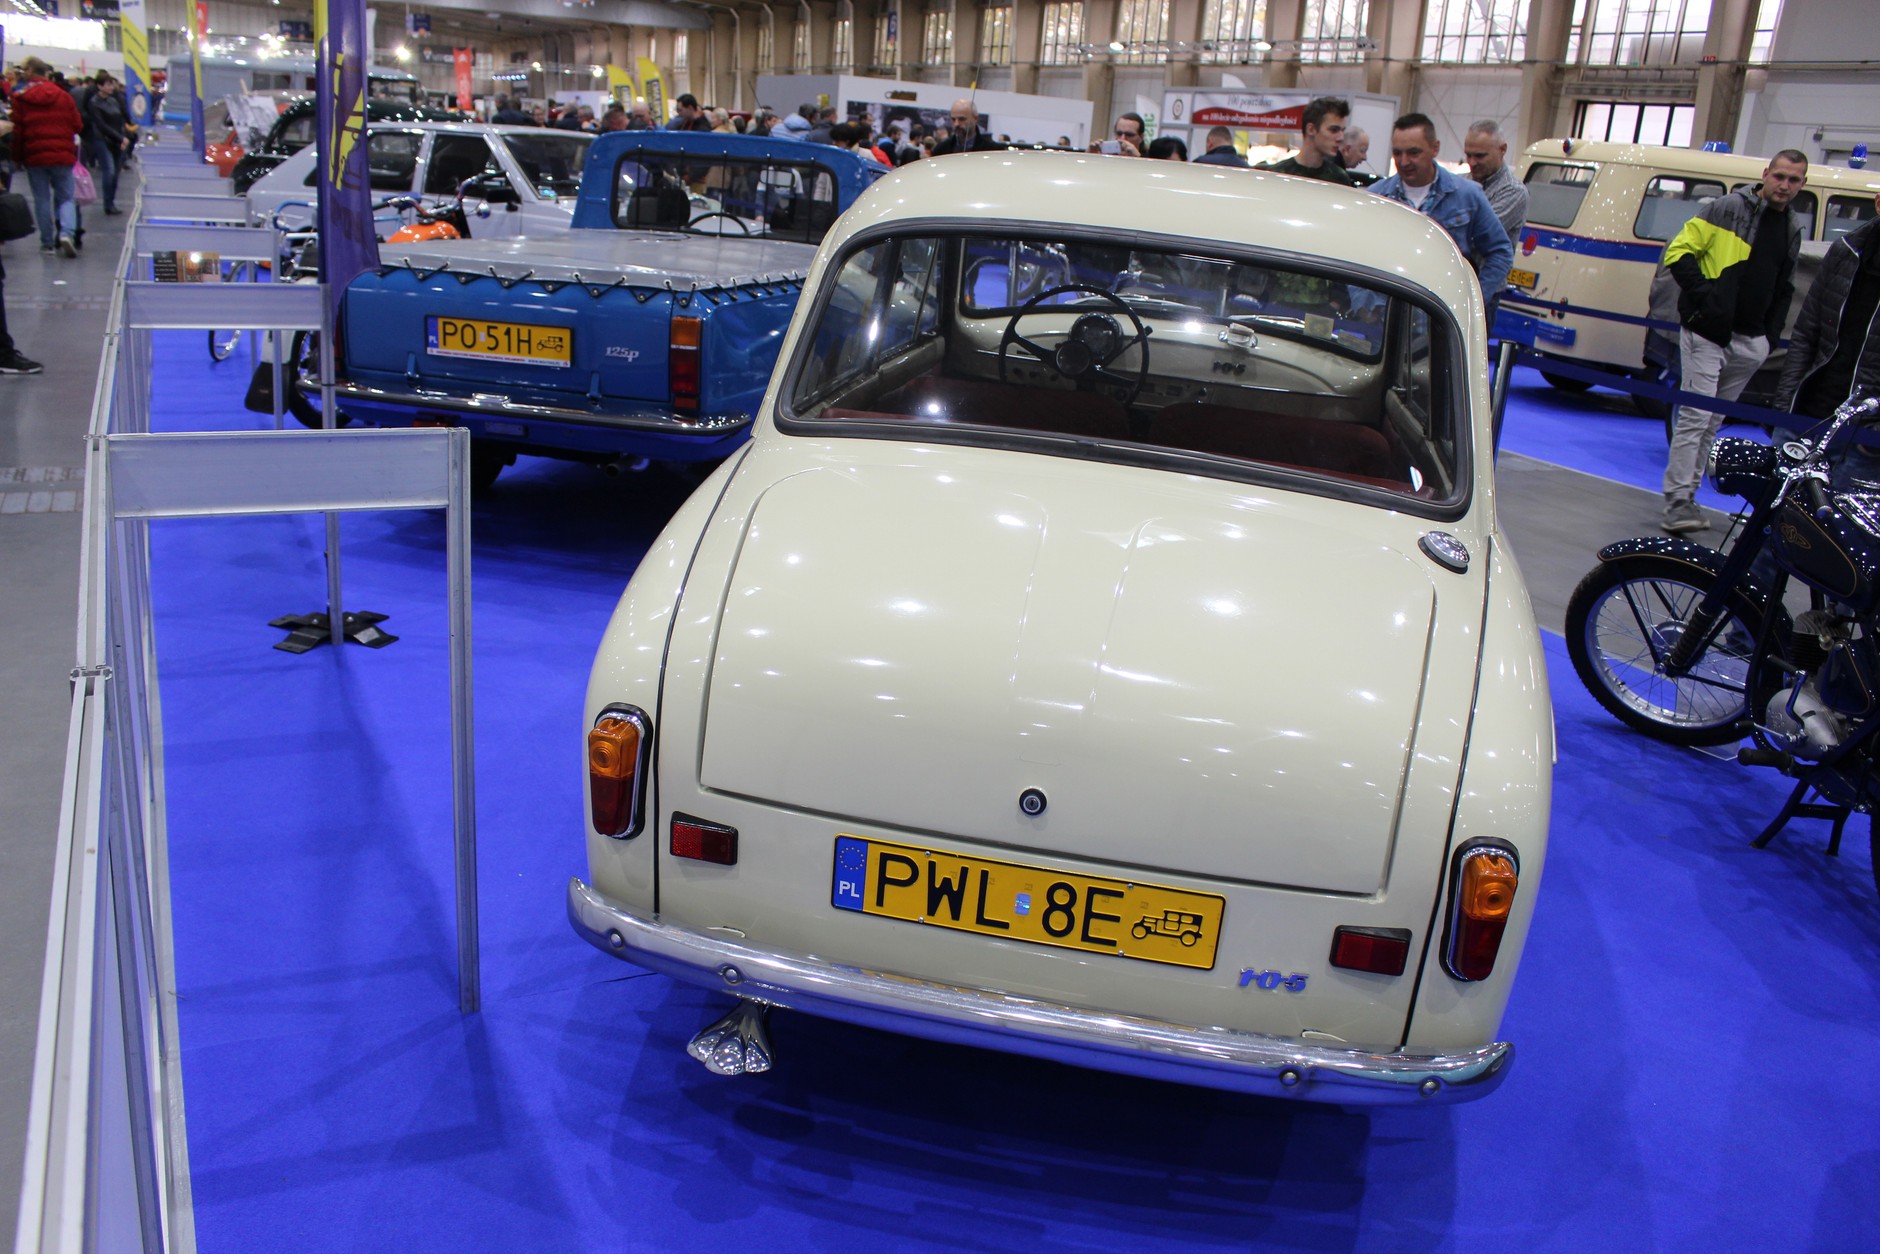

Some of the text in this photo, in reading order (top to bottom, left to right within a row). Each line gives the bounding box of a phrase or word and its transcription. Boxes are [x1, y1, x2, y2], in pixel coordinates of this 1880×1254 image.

[428, 335, 438, 344] PL
[442, 321, 532, 354] PO 51H
[604, 346, 639, 362] 125p
[838, 880, 860, 899] PL
[876, 852, 1125, 947] PWL 8E
